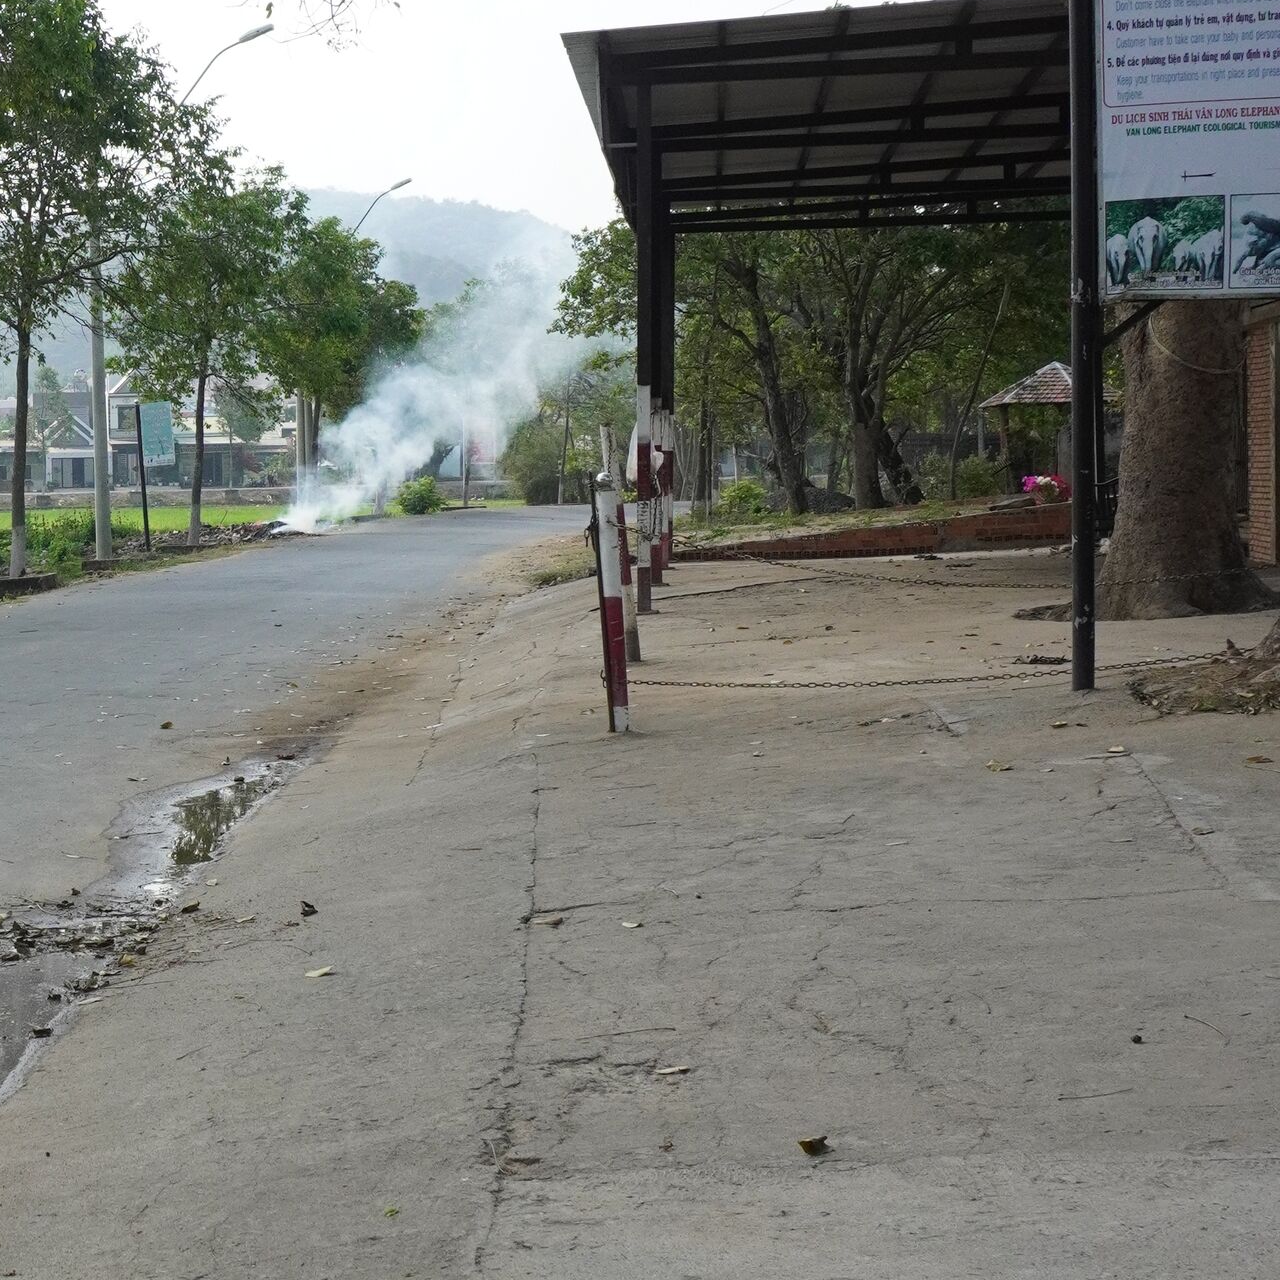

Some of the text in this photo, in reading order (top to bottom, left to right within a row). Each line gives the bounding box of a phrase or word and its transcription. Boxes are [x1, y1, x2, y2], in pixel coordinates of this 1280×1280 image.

[1106, 20, 1114, 31] 4.
[1116, 19, 1129, 31] Quý
[1132, 18, 1154, 29] khách
[1127, 56, 1139, 66] các
[1111, 114, 1123, 125] DU
[1125, 112, 1146, 126] LỊCH
[1148, 111, 1169, 122] SINH
[1172, 107, 1193, 122] THÁI
[1195, 106, 1213, 120] VÂN
[1215, 107, 1238, 119] LONG
[1126, 121, 1247, 137] VAN LONG ELEPHANT ECOLOGICAL
